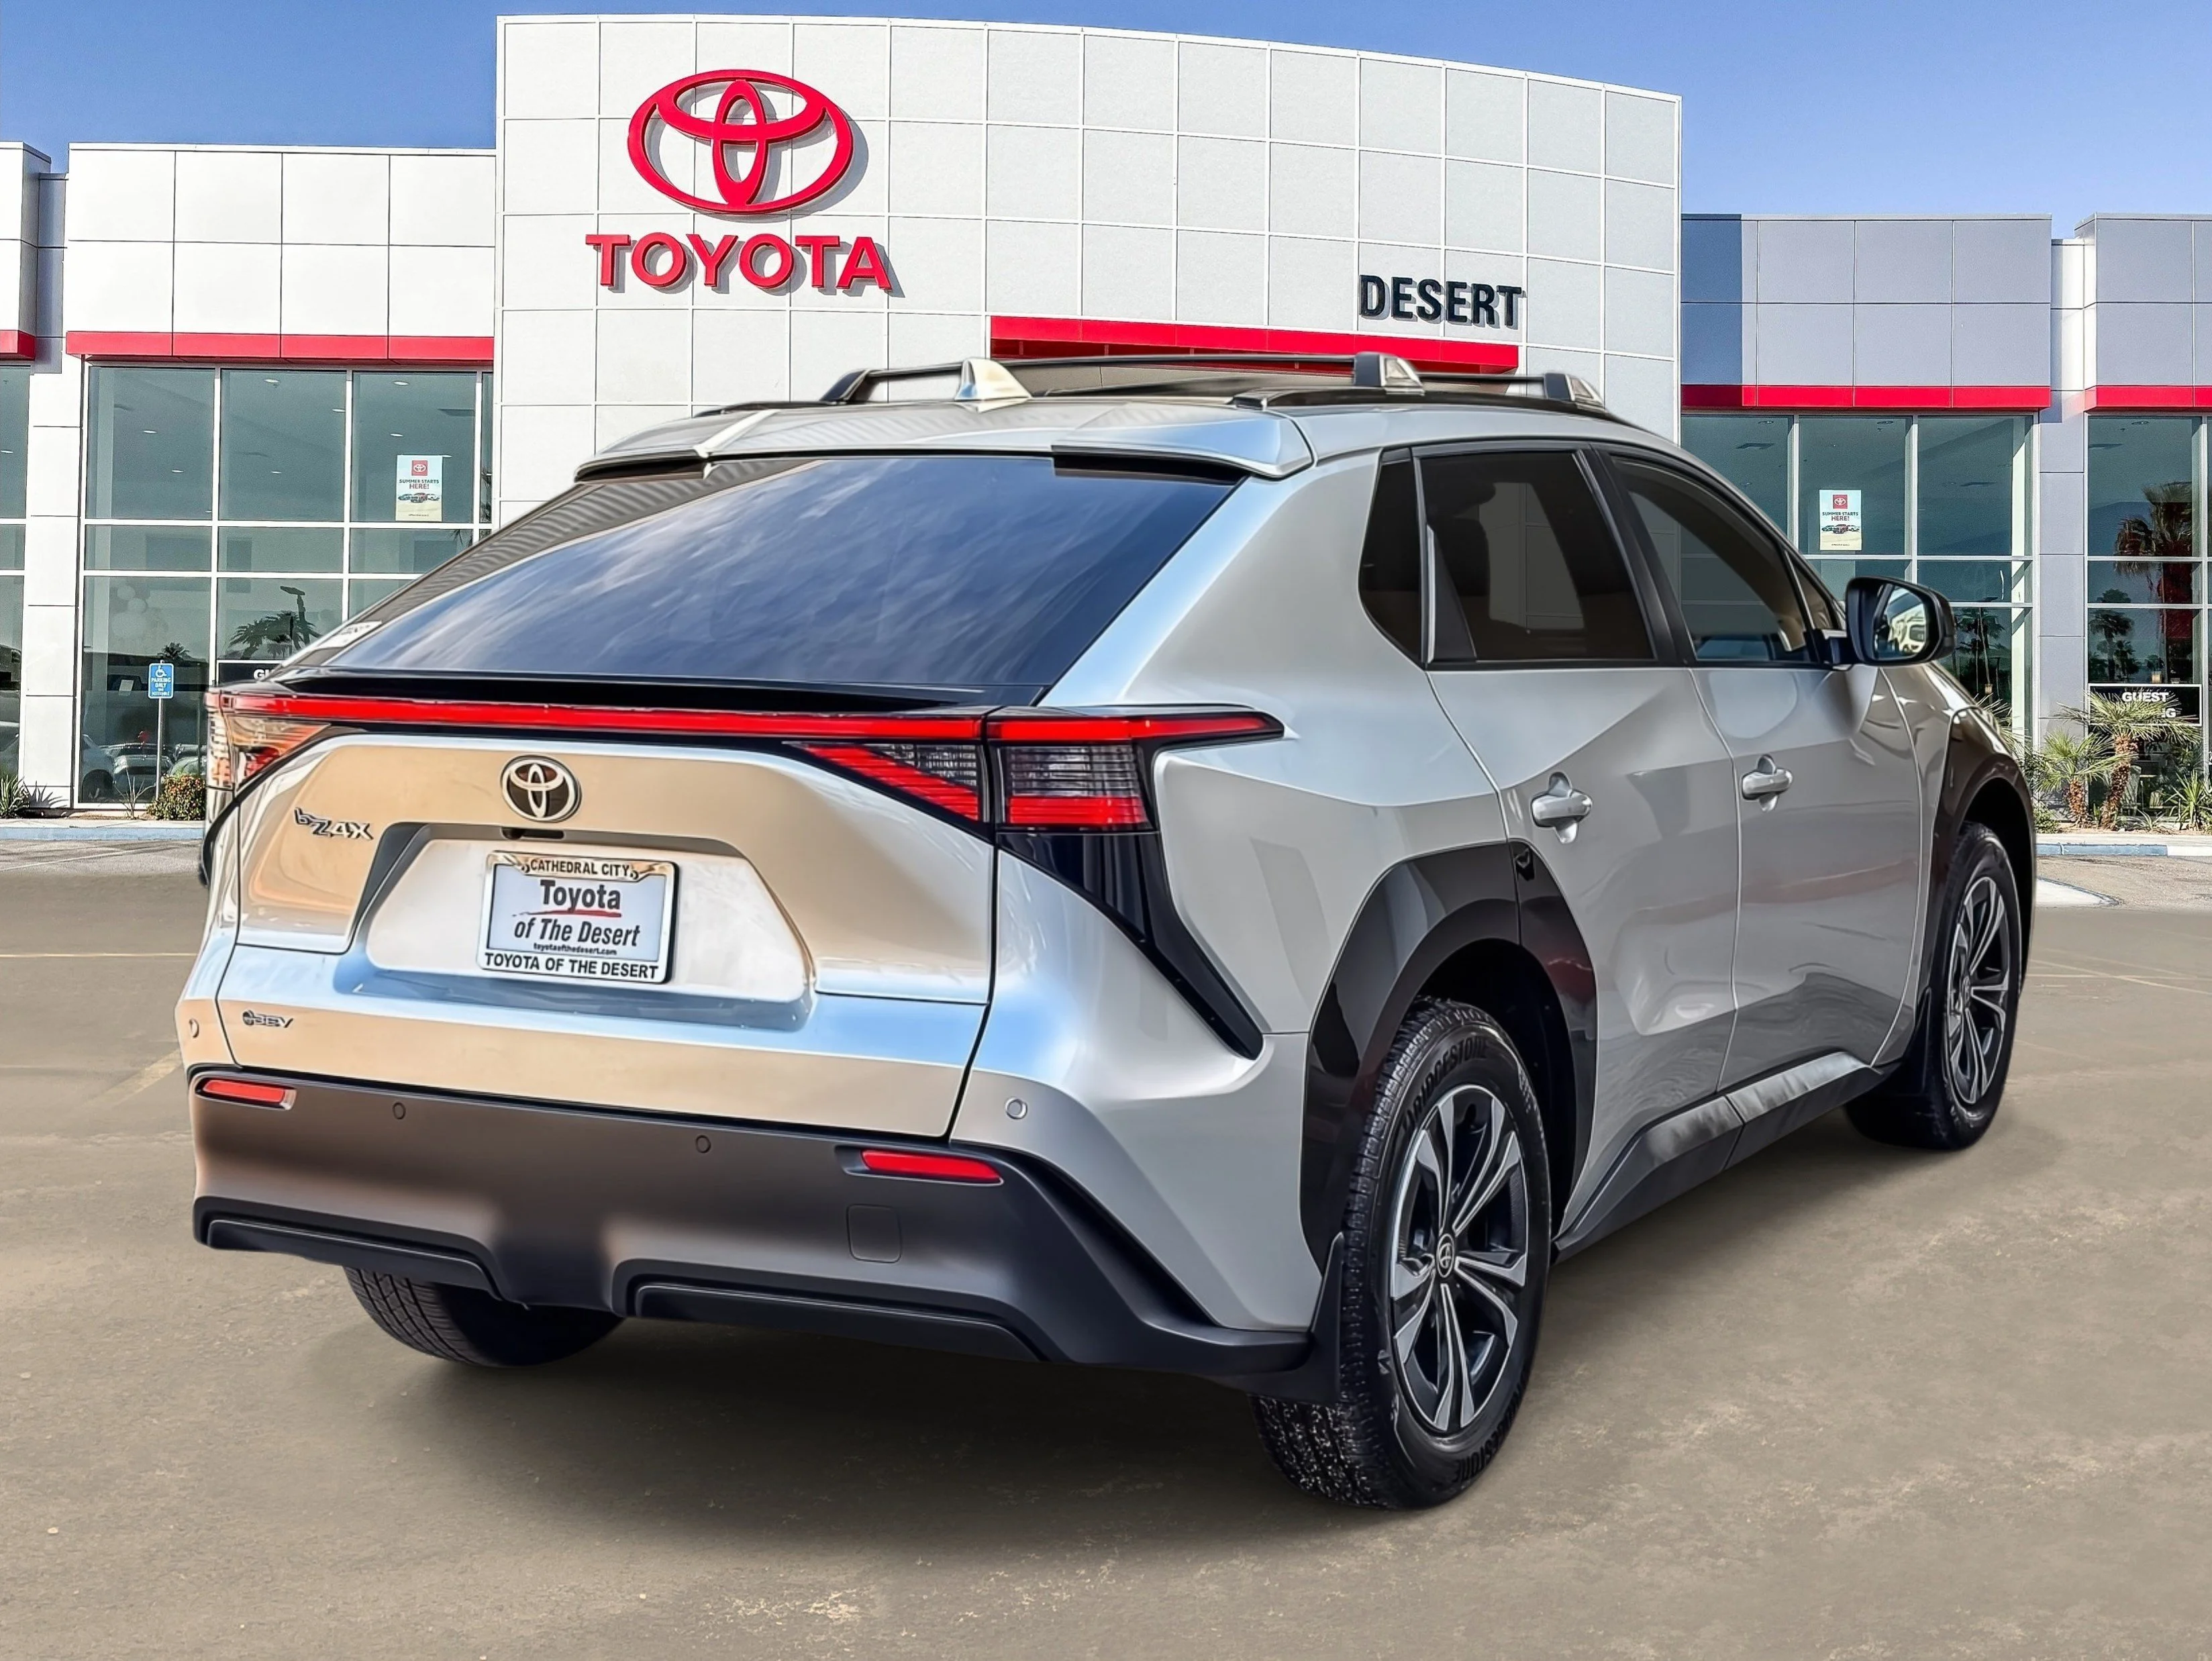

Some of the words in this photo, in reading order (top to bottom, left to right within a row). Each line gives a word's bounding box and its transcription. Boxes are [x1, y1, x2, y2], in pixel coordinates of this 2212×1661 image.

[585, 232, 893, 292] TOYOTA
[1359, 274, 1522, 327] DESERT
[2121, 692, 2169, 702] GUEST
[530, 859, 597, 874] CATHEDRAL
[601, 864, 630, 876] CITY
[540, 880, 621, 912] Toyota
[514, 917, 536, 938] of
[540, 919, 571, 941] The
[578, 921, 640, 946] Desert
[534, 943, 617, 955] toyotaofthedesert.com
[485, 952, 540, 970] TOYOTA
[545, 958, 564, 972] OF
[569, 959, 597, 974] THE
[601, 962, 658, 979] DESERT
